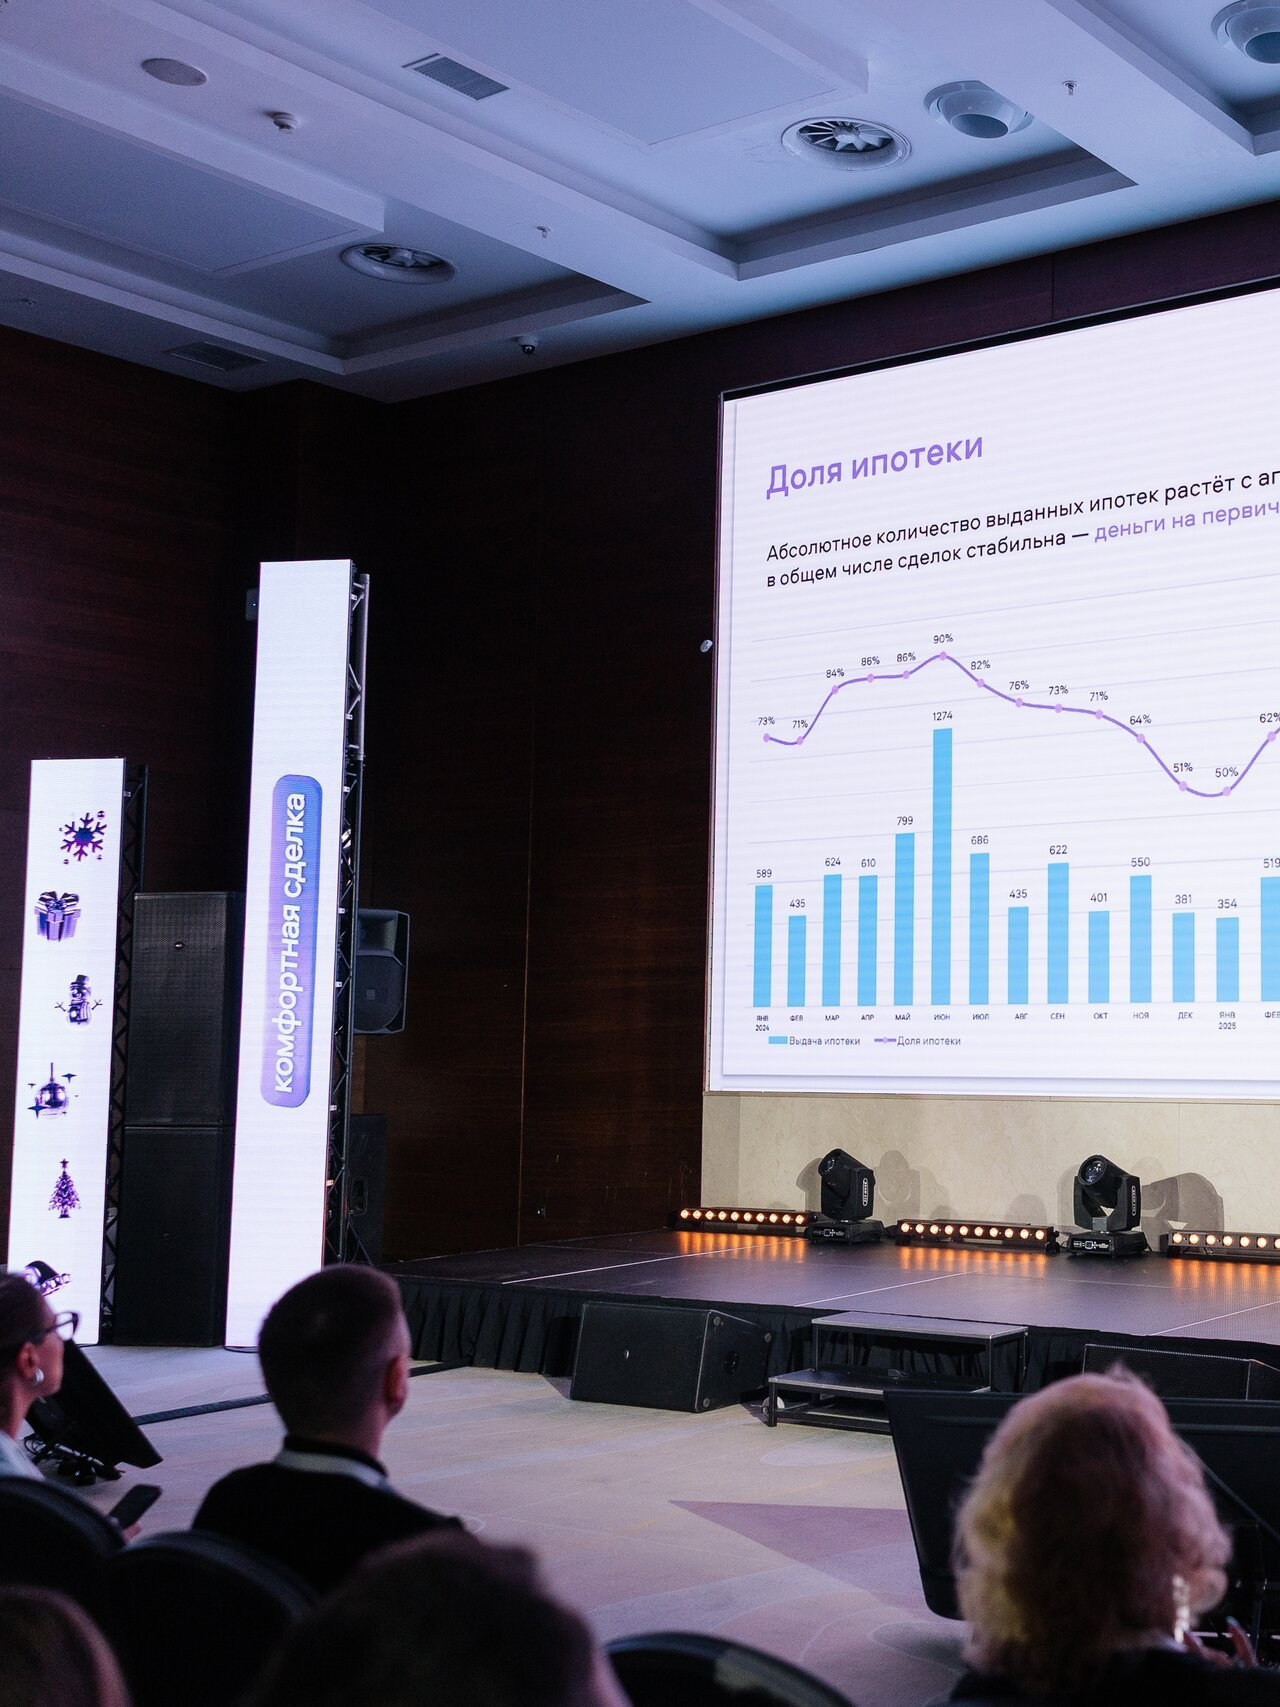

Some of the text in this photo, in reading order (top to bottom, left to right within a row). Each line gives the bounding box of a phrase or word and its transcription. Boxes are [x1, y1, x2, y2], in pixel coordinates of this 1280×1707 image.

[766, 436, 984, 499] Доля ипотеки
[766, 532, 872, 562] Абсолютное
[876, 516, 982, 545] количество
[986, 501, 1084, 529] выданных
[1088, 490, 1159, 513] ипотек
[1164, 476, 1236, 506] растёт
[1240, 475, 1253, 490] с
[767, 574, 777, 588] в
[779, 566, 837, 587] общем
[842, 557, 893, 575] числе
[897, 547, 962, 571] сделок
[966, 532, 1066, 559] стабильна
[1094, 518, 1166, 544] деньги
[1172, 513, 1196, 529] на
[932, 633, 954, 645] 90%
[860, 655, 881, 667] 86%
[896, 652, 917, 663] 86%
[970, 659, 992, 671] 82%
[825, 668, 845, 679] 84%
[1008, 679, 1030, 691] 76%
[1048, 684, 1069, 696] 73%
[1089, 690, 1109, 702] 71%
[757, 715, 776, 727] 73%
[932, 710, 953, 722] 1274
[1128, 714, 1152, 726] 64%
[792, 719, 809, 730] 71%
[1172, 762, 1194, 774] 51%
[1214, 767, 1240, 778] 50%
[896, 815, 914, 826] 799
[970, 834, 989, 845] 686
[1049, 844, 1068, 856] 622
[824, 856, 842, 868] 624
[860, 857, 877, 868] 610
[1130, 856, 1151, 868] 550
[756, 868, 773, 879] 589
[1009, 888, 1028, 899] 435
[1089, 892, 1108, 903] 401
[1174, 893, 1192, 905] 381
[789, 898, 806, 909] 435
[1217, 898, 1238, 910] 354
[270, 793, 307, 1094] комфортная сделка
[824, 1014, 840, 1022] МАР
[860, 1013, 875, 1021] АПР
[894, 1012, 911, 1021] МАЙ
[933, 1013, 951, 1021] ИЮН
[1050, 1012, 1065, 1020] СЕН
[1093, 1012, 1109, 1020] ОКТ
[1177, 1011, 1193, 1020] ДЕК
[755, 1024, 770, 1032] 2024
[1218, 1022, 1237, 1030] 2025
[789, 1036, 861, 1047] Выдача ипотеки
[896, 1036, 961, 1047] Доля ипотеки
